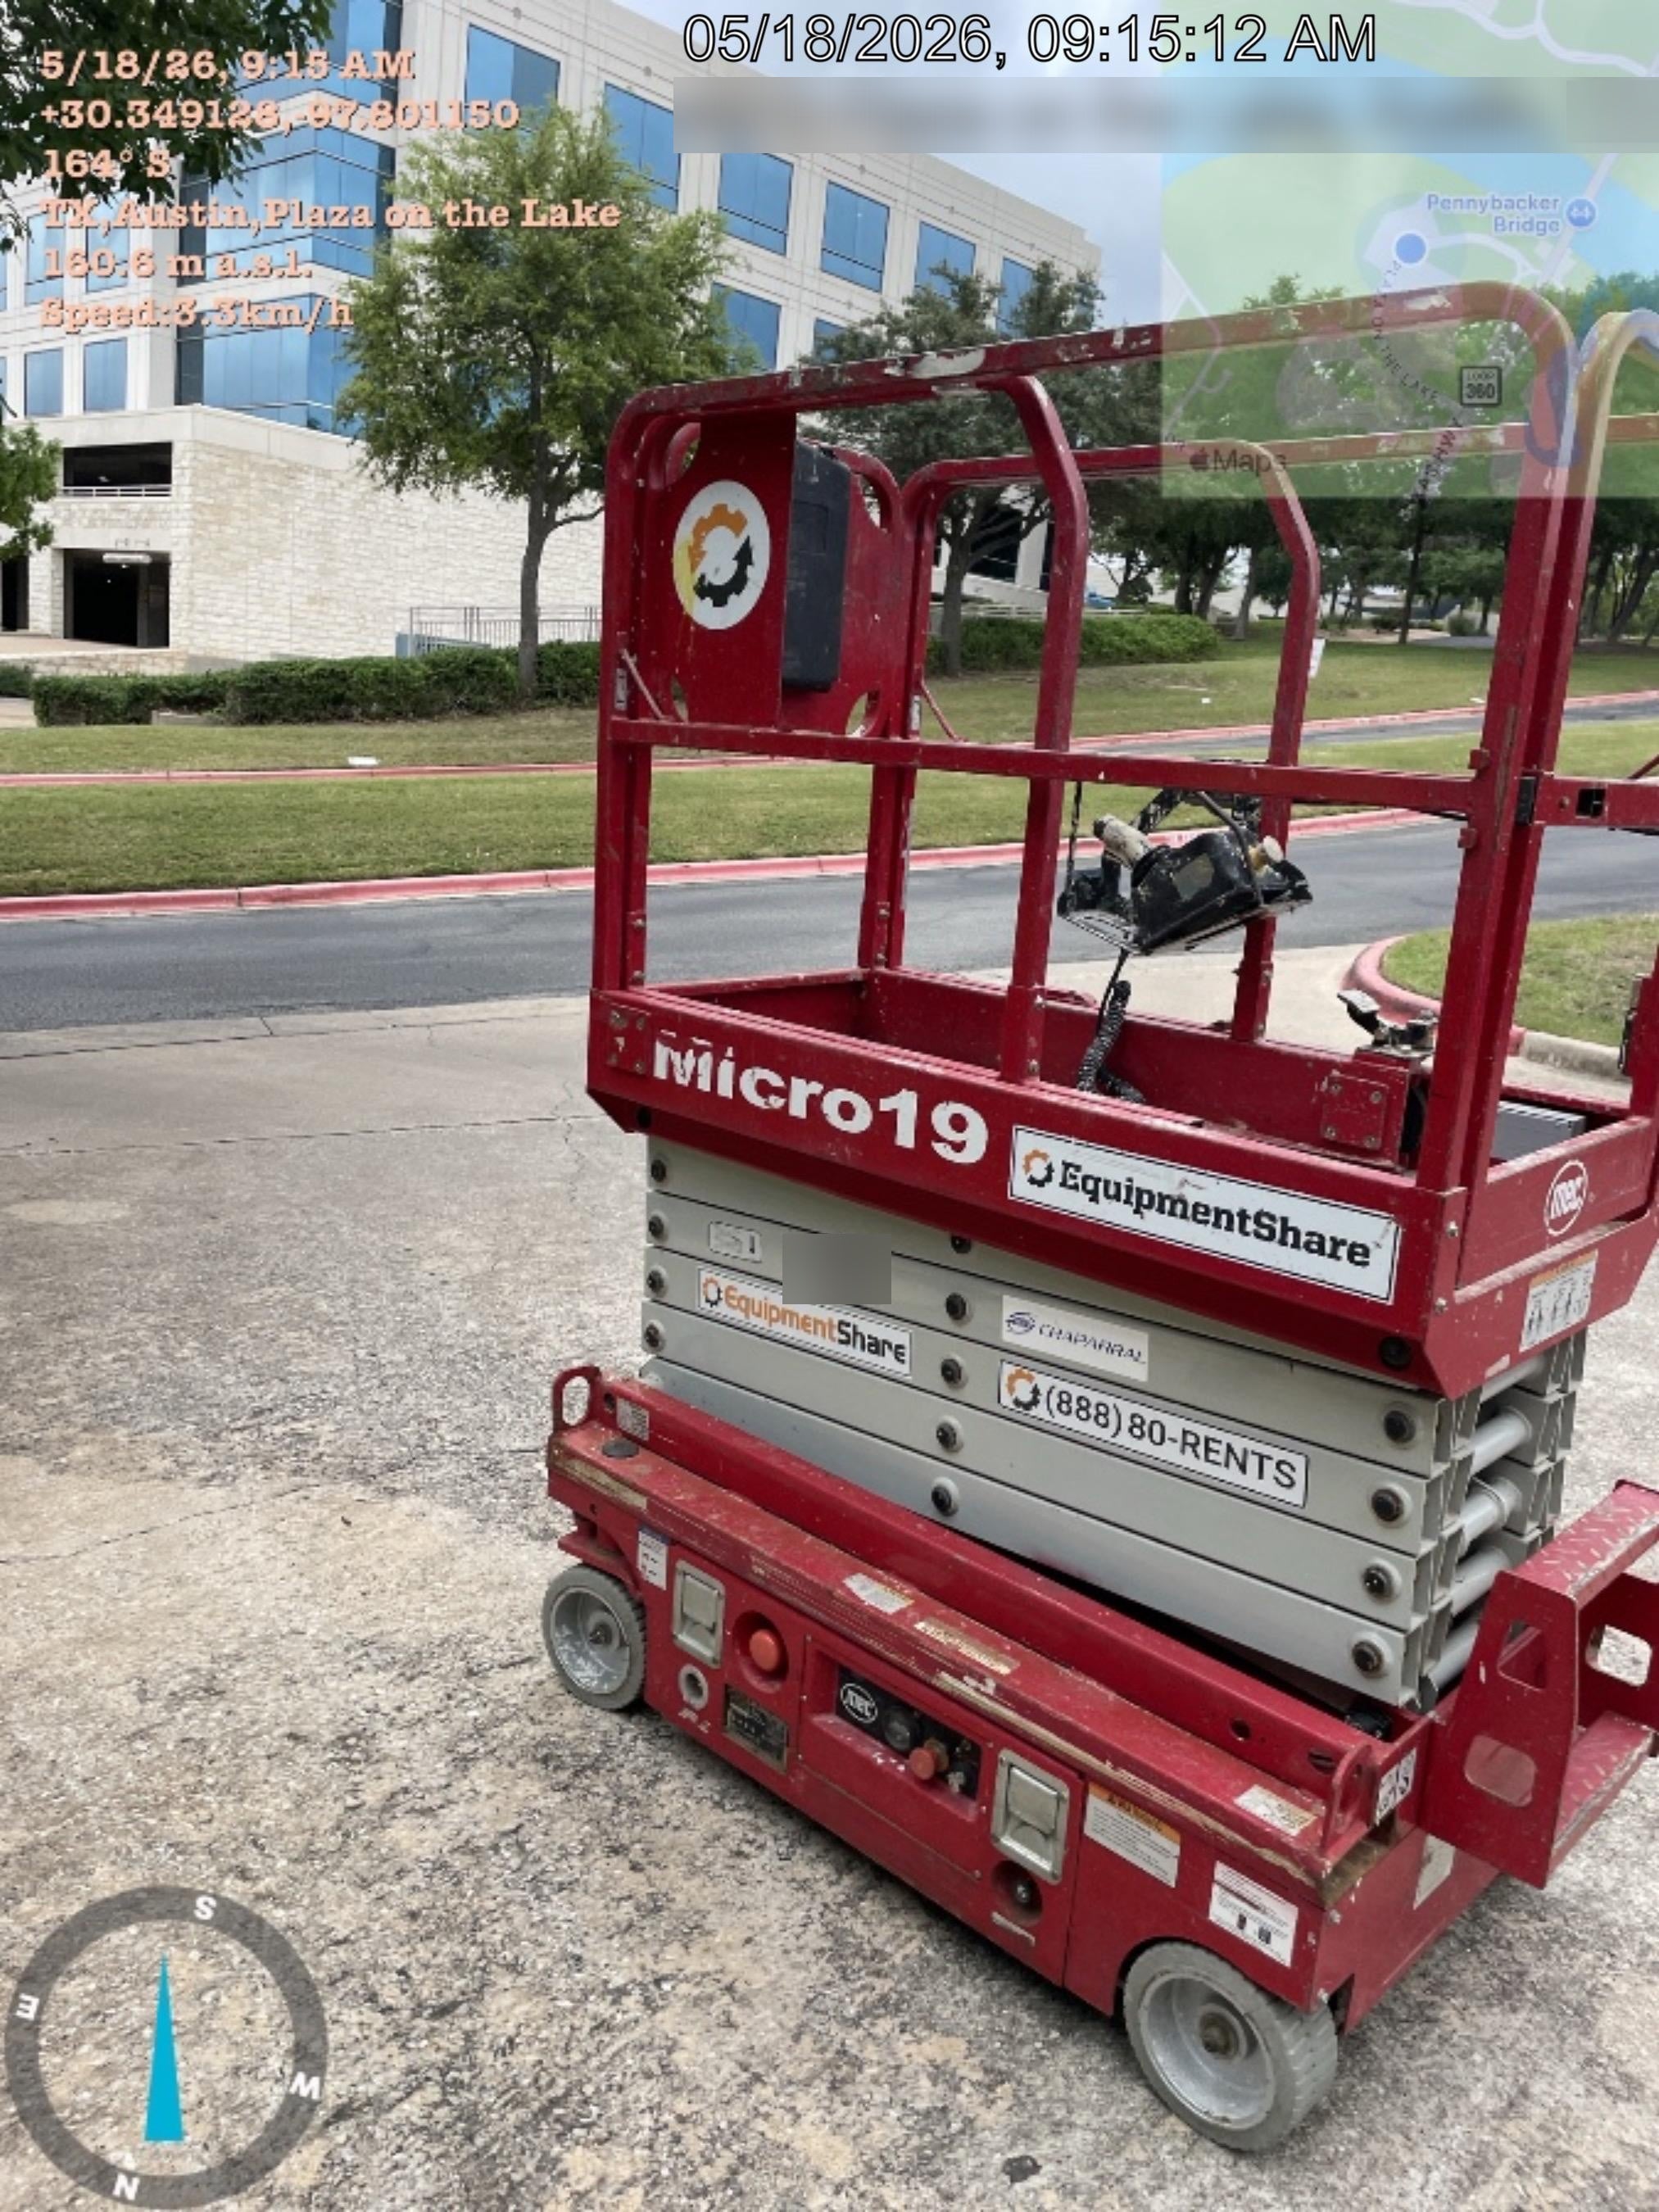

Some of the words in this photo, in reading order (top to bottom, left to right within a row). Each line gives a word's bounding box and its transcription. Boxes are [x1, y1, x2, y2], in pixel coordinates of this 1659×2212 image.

[653, 1029, 989, 1164] Micro19
[1058, 1159, 1371, 1268] EquipmentShare
[723, 1284, 907, 1365] EquipmentShare
